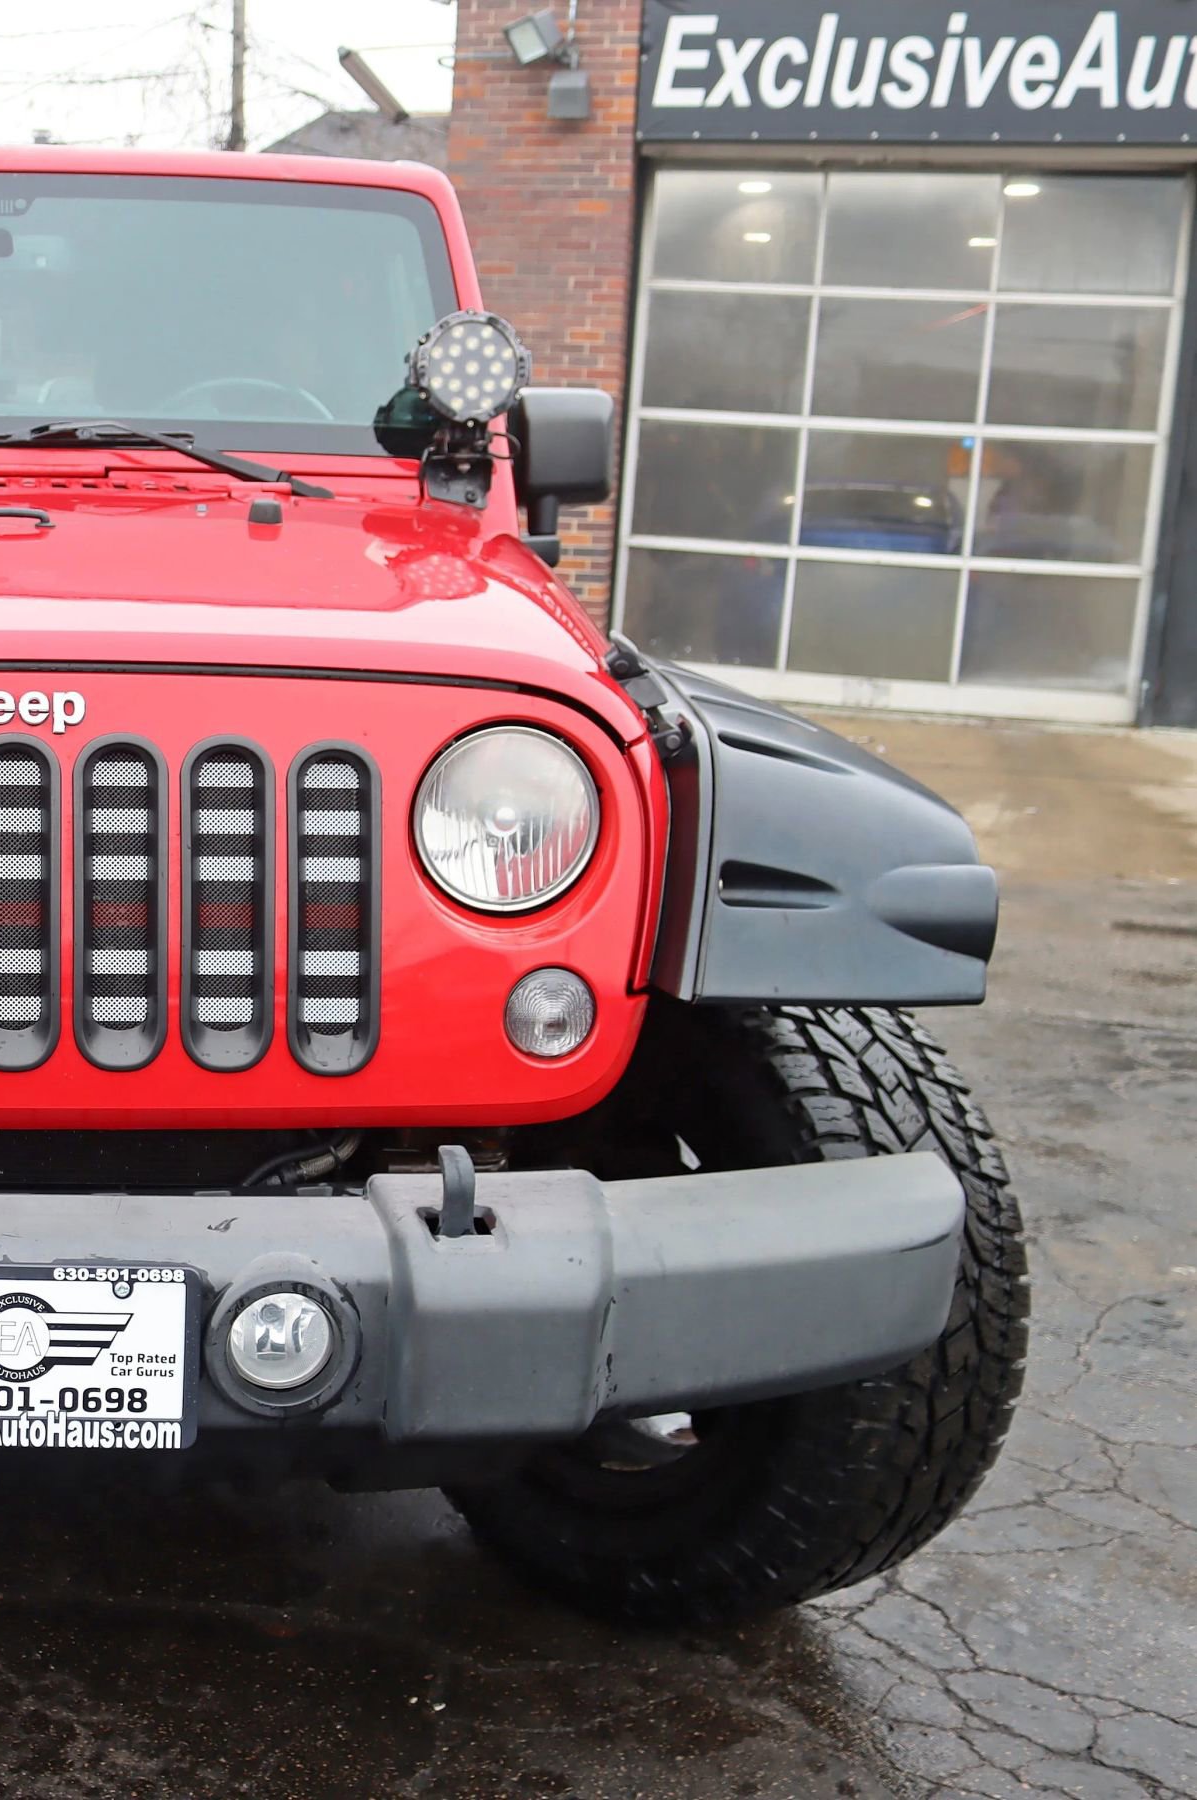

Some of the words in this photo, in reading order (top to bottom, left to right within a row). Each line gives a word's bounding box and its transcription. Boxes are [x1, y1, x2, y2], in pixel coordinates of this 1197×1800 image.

[53, 1267, 185, 1282] 630-501-0698
[110, 1353, 132, 1365] Top
[137, 1353, 176, 1364] Rated
[111, 1366, 132, 1376] Car
[136, 1368, 174, 1377] Gurus
